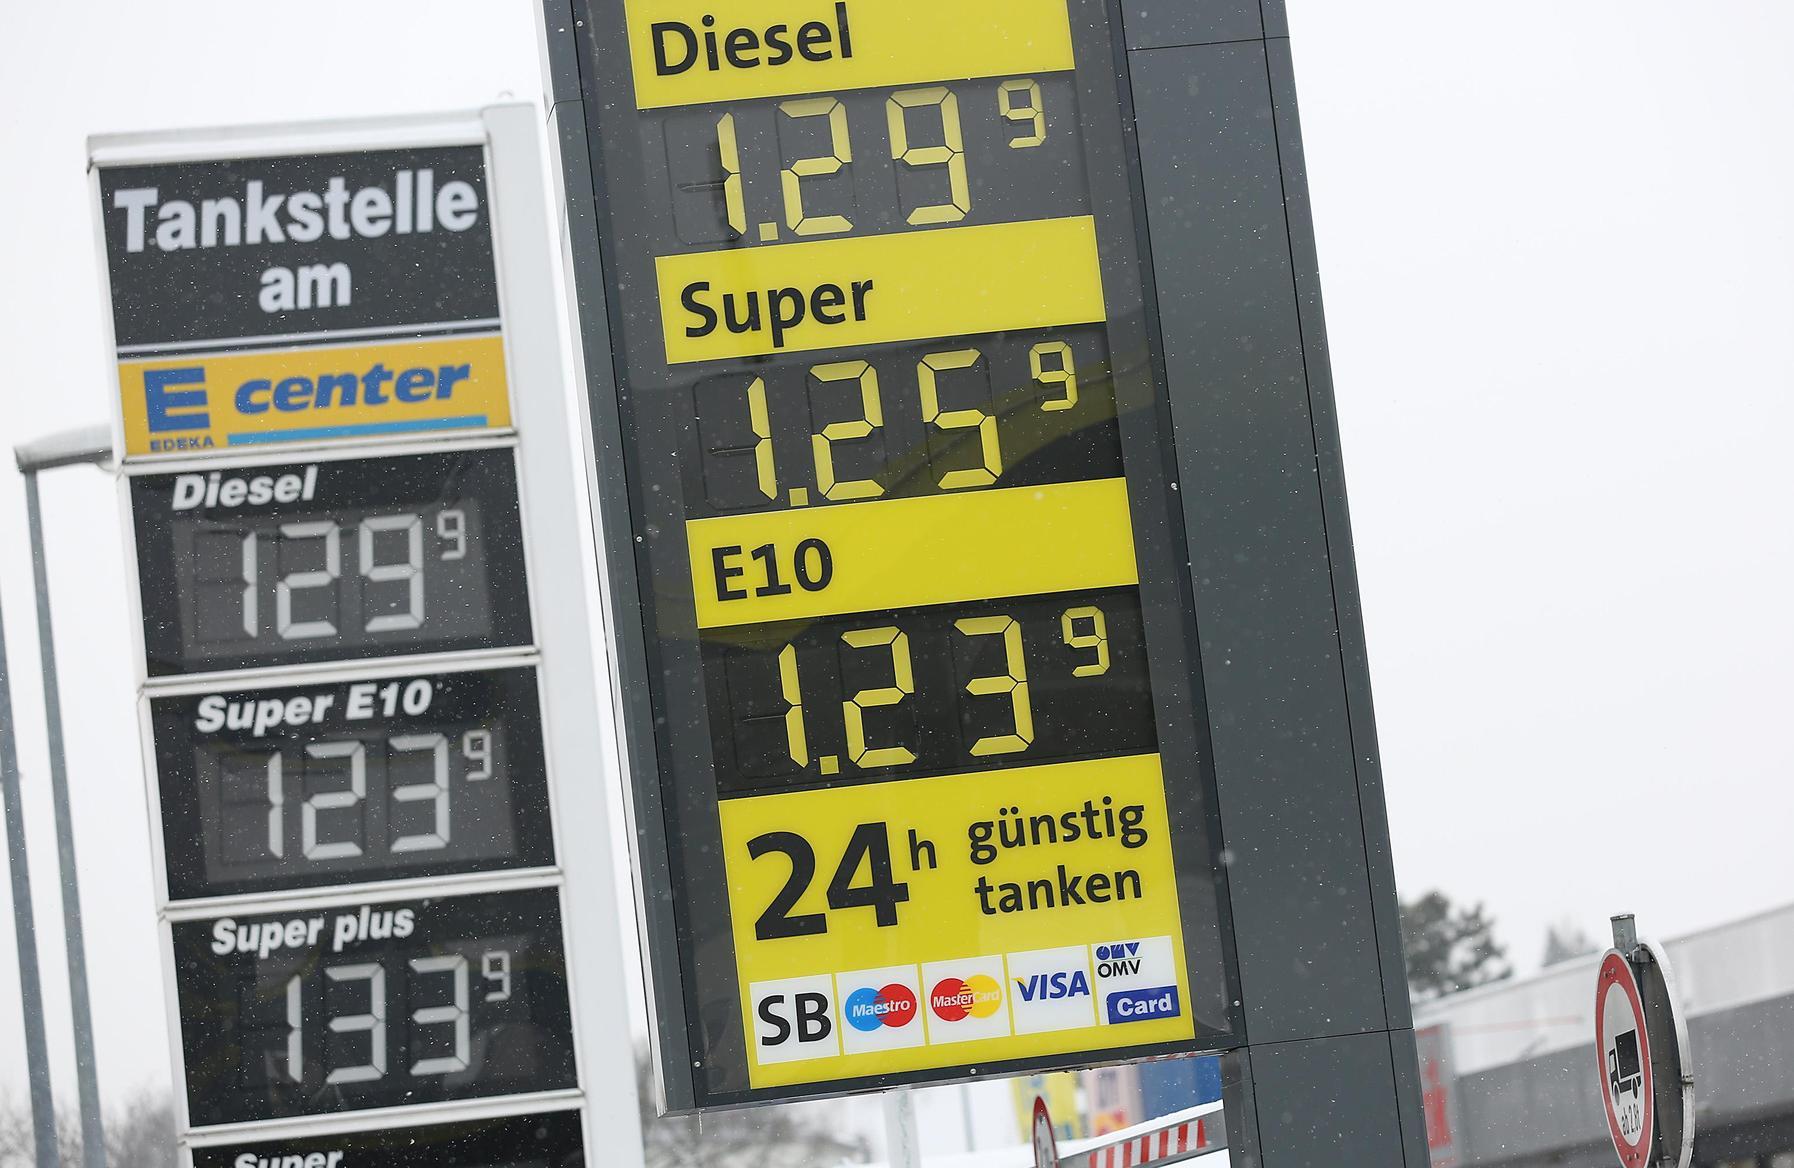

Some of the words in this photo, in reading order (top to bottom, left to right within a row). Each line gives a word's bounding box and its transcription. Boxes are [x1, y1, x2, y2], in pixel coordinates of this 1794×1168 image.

[651, 2, 853, 76] Diesel
[114, 169, 478, 253] Tankstelle
[259, 262, 352, 313] am
[681, 280, 873, 347] Super
[144, 367, 210, 433] E
[235, 363, 471, 414] center
[151, 435, 215, 451] EDEKA
[172, 465, 318, 511] Diesel
[712, 538, 833, 601] E10
[195, 694, 334, 737] Super
[345, 679, 433, 719] E10
[968, 796, 1148, 866] günstig
[974, 864, 1142, 915] tanken
[210, 916, 325, 958] Super
[332, 905, 415, 951] plus
[1015, 970, 1090, 1002] VISA
[1097, 959, 1141, 978] OMV
[758, 992, 832, 1046] SB
[852, 999, 911, 1018] Maestro
[933, 990, 999, 1008] MasterCard
[1116, 993, 1172, 1017] Card
